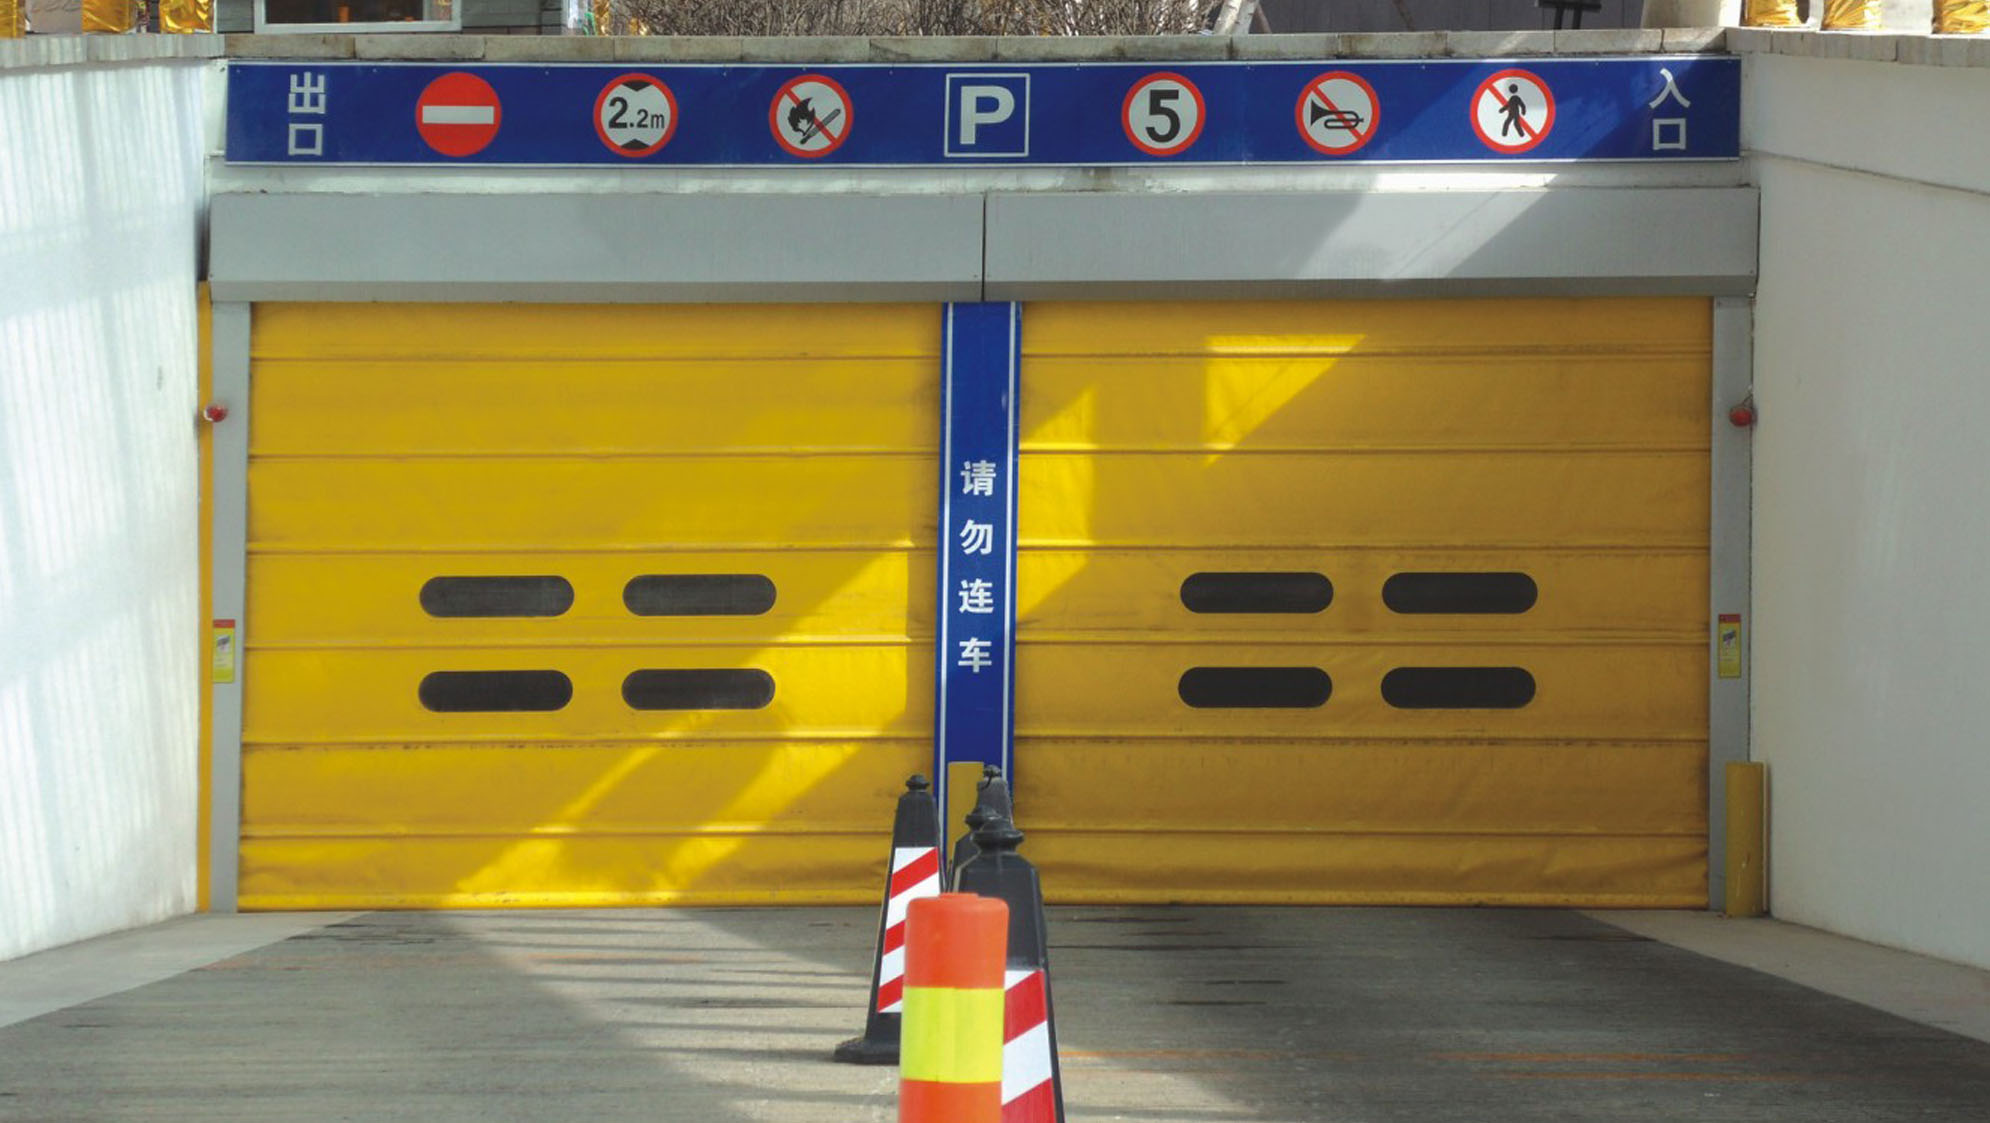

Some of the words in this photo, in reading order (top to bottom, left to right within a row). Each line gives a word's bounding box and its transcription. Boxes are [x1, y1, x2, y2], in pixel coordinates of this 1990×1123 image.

[288, 71, 326, 155] 出口
[608, 96, 665, 129] 2.2m
[960, 85, 1015, 144] P
[1146, 89, 1180, 143] 5
[1649, 68, 1691, 150] 入口
[958, 460, 996, 673] 请勿连车
